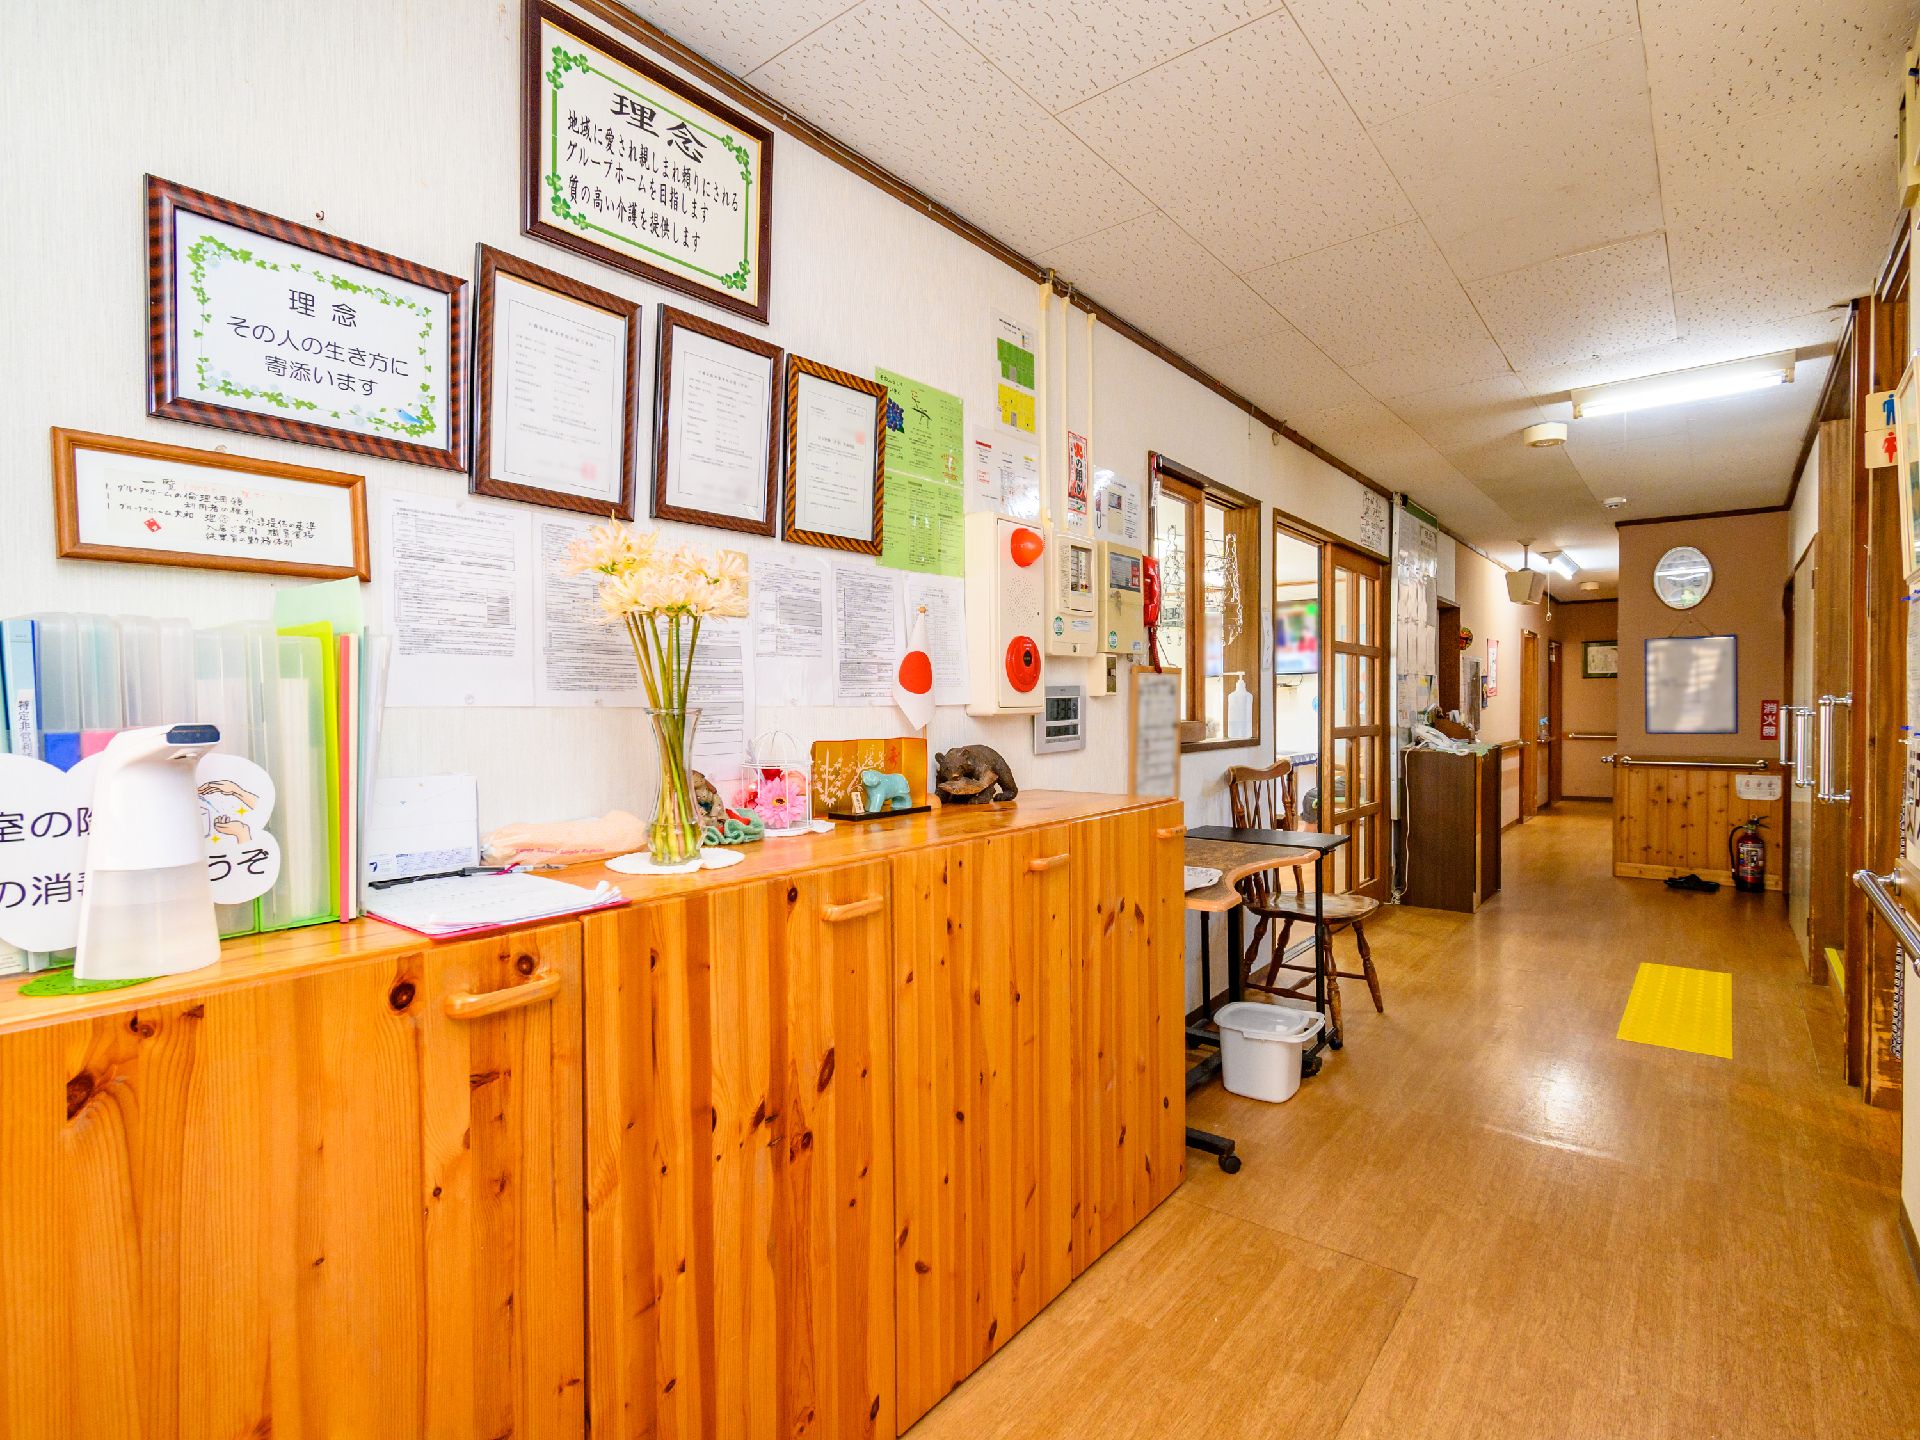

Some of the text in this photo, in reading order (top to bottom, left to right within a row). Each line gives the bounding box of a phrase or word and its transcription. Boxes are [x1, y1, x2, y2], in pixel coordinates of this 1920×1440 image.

[567, 108, 738, 212] 地域に愛され親しまれ頼りにされる
[610, 92, 707, 164] 理念
[566, 140, 709, 223] グループホームを目指します
[569, 174, 701, 253] 質の高い介護を提供します
[288, 288, 357, 328] 理念
[226, 315, 409, 377] その人の生き方に
[264, 355, 379, 396] 寄添います
[1763, 703, 1777, 737] 消火器
